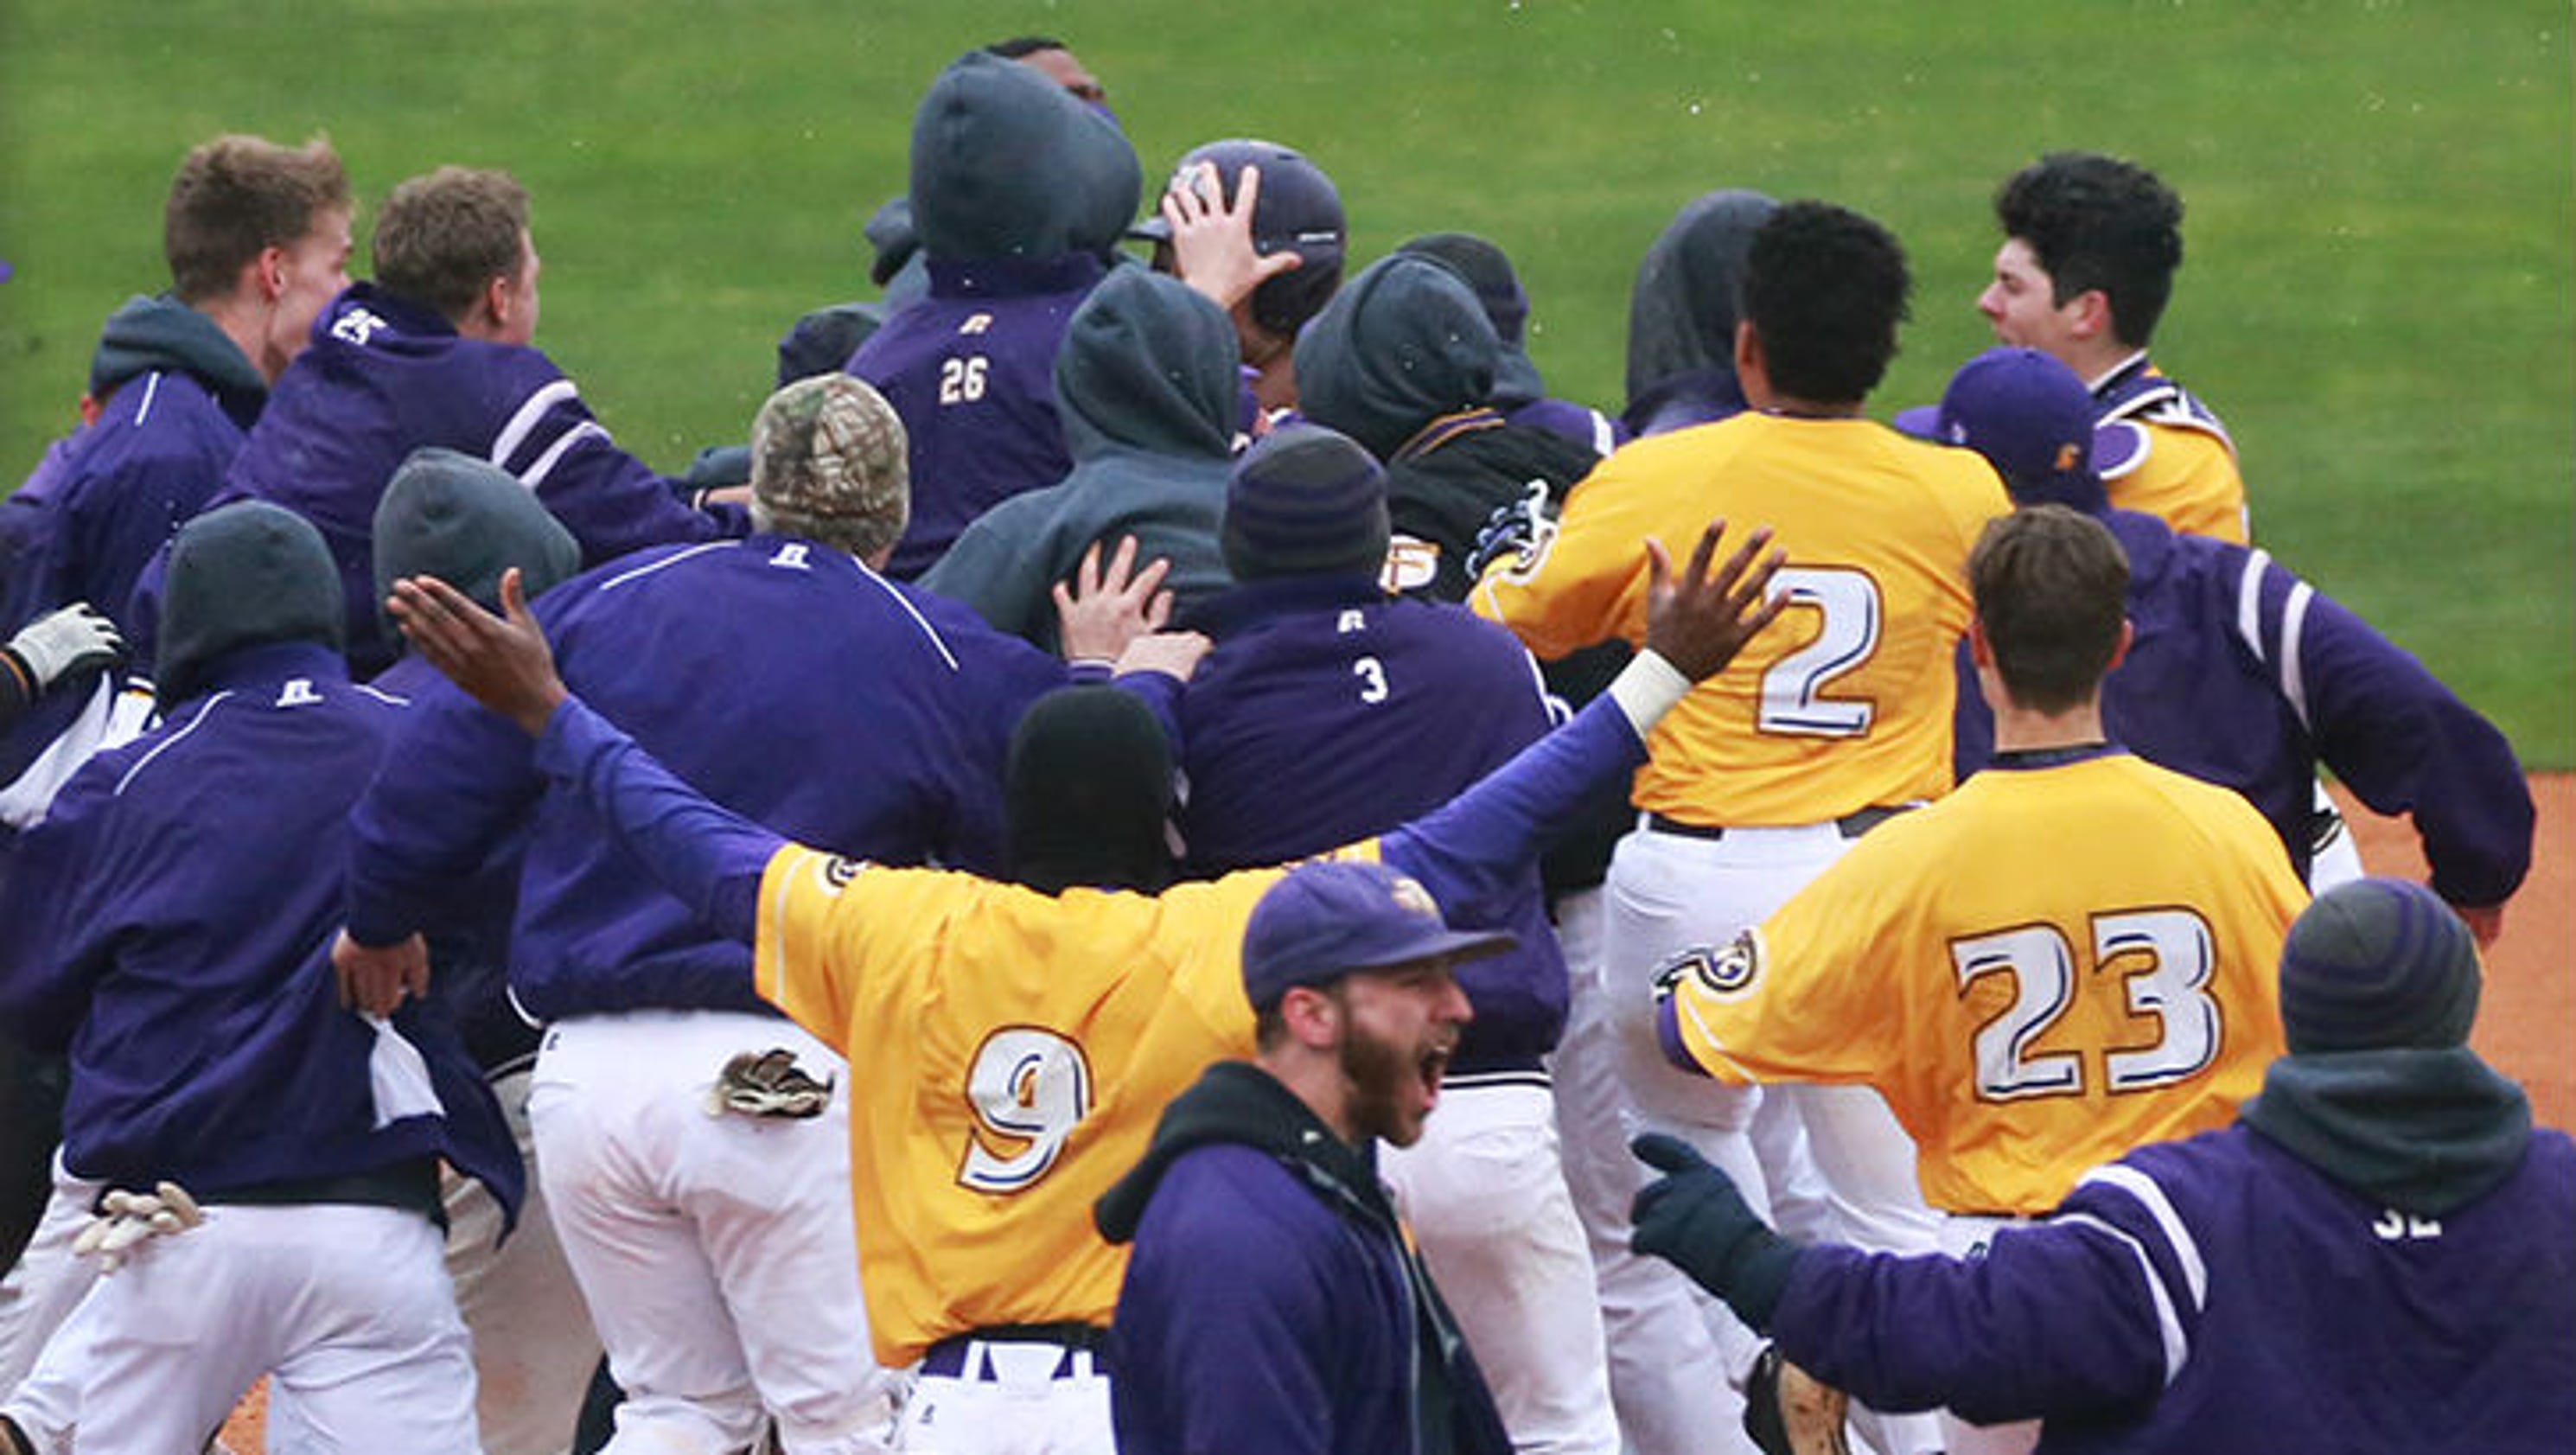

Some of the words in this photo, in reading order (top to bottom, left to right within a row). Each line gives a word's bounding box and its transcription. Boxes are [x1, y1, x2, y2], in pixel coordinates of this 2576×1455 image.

[940, 356, 989, 405] 26
[1354, 657, 1388, 703] 3
[1754, 565, 1885, 741] 2
[1948, 905, 2224, 1104] 23
[954, 1024, 1095, 1198] 9
